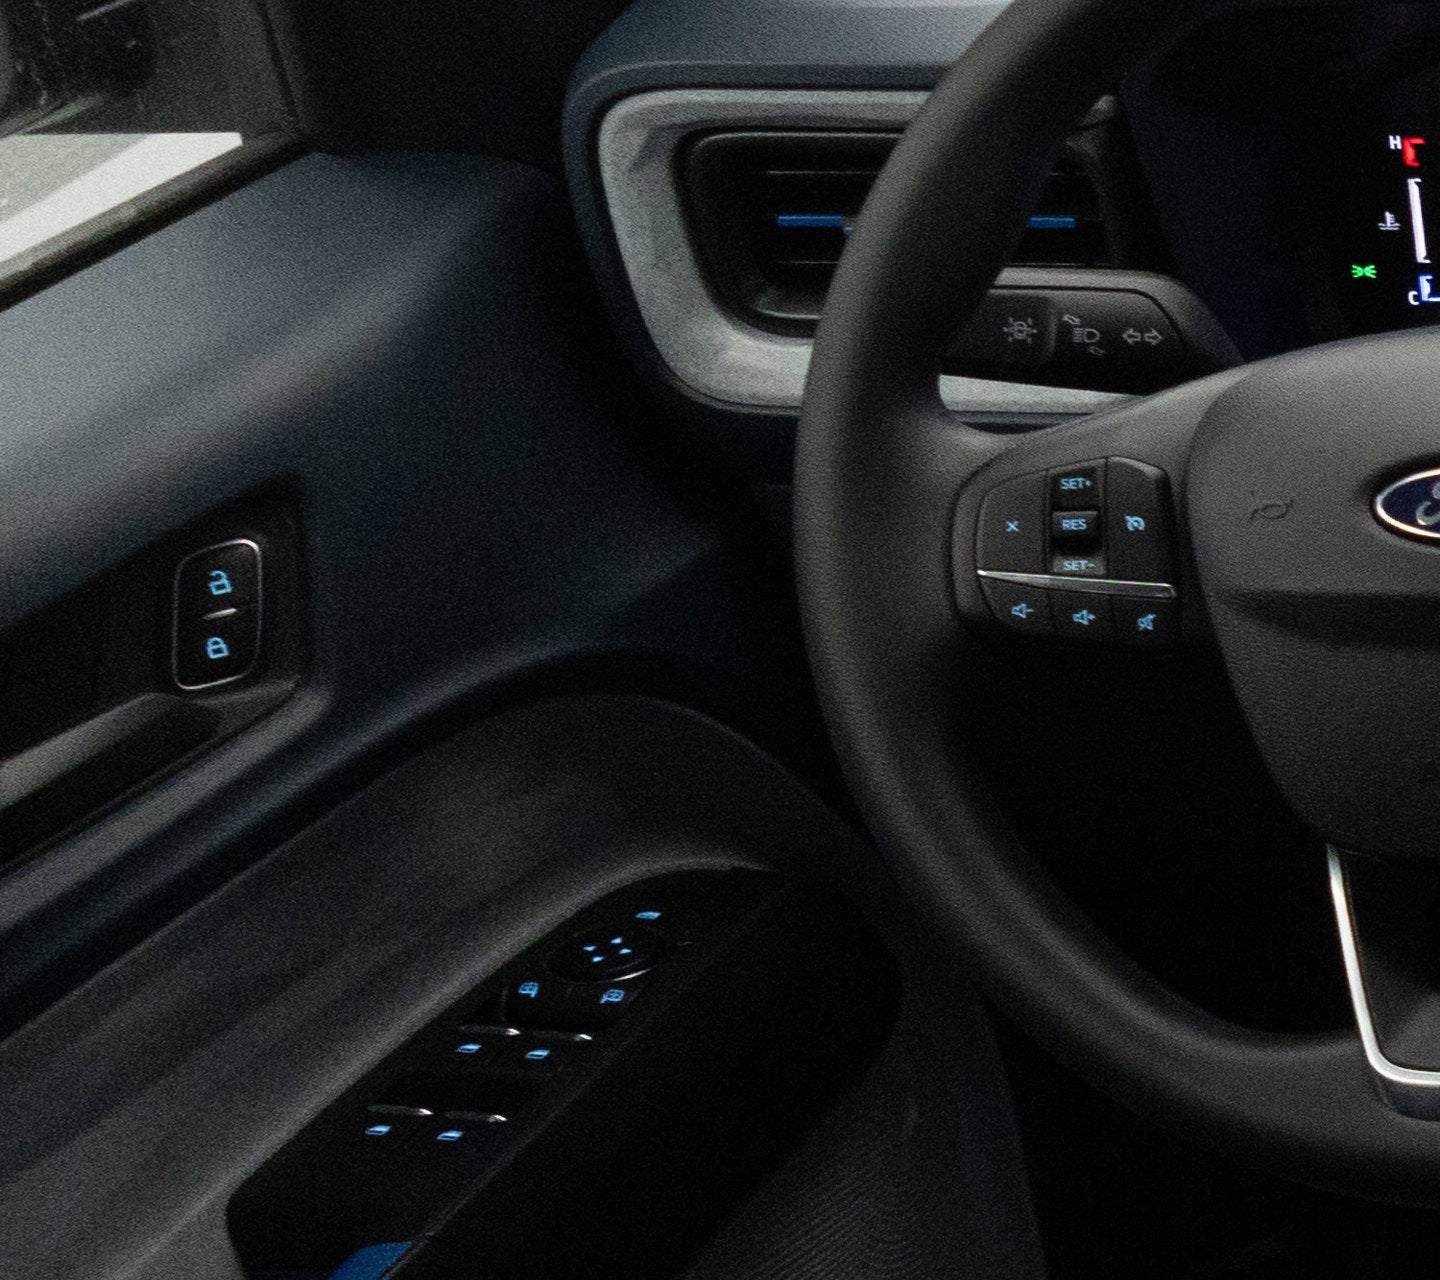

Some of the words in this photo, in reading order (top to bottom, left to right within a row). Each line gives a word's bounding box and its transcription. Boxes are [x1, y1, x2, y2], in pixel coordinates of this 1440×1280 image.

[1388, 135, 1402, 150] H
[1408, 291, 1419, 306] C
[1062, 518, 1087, 531] RES
